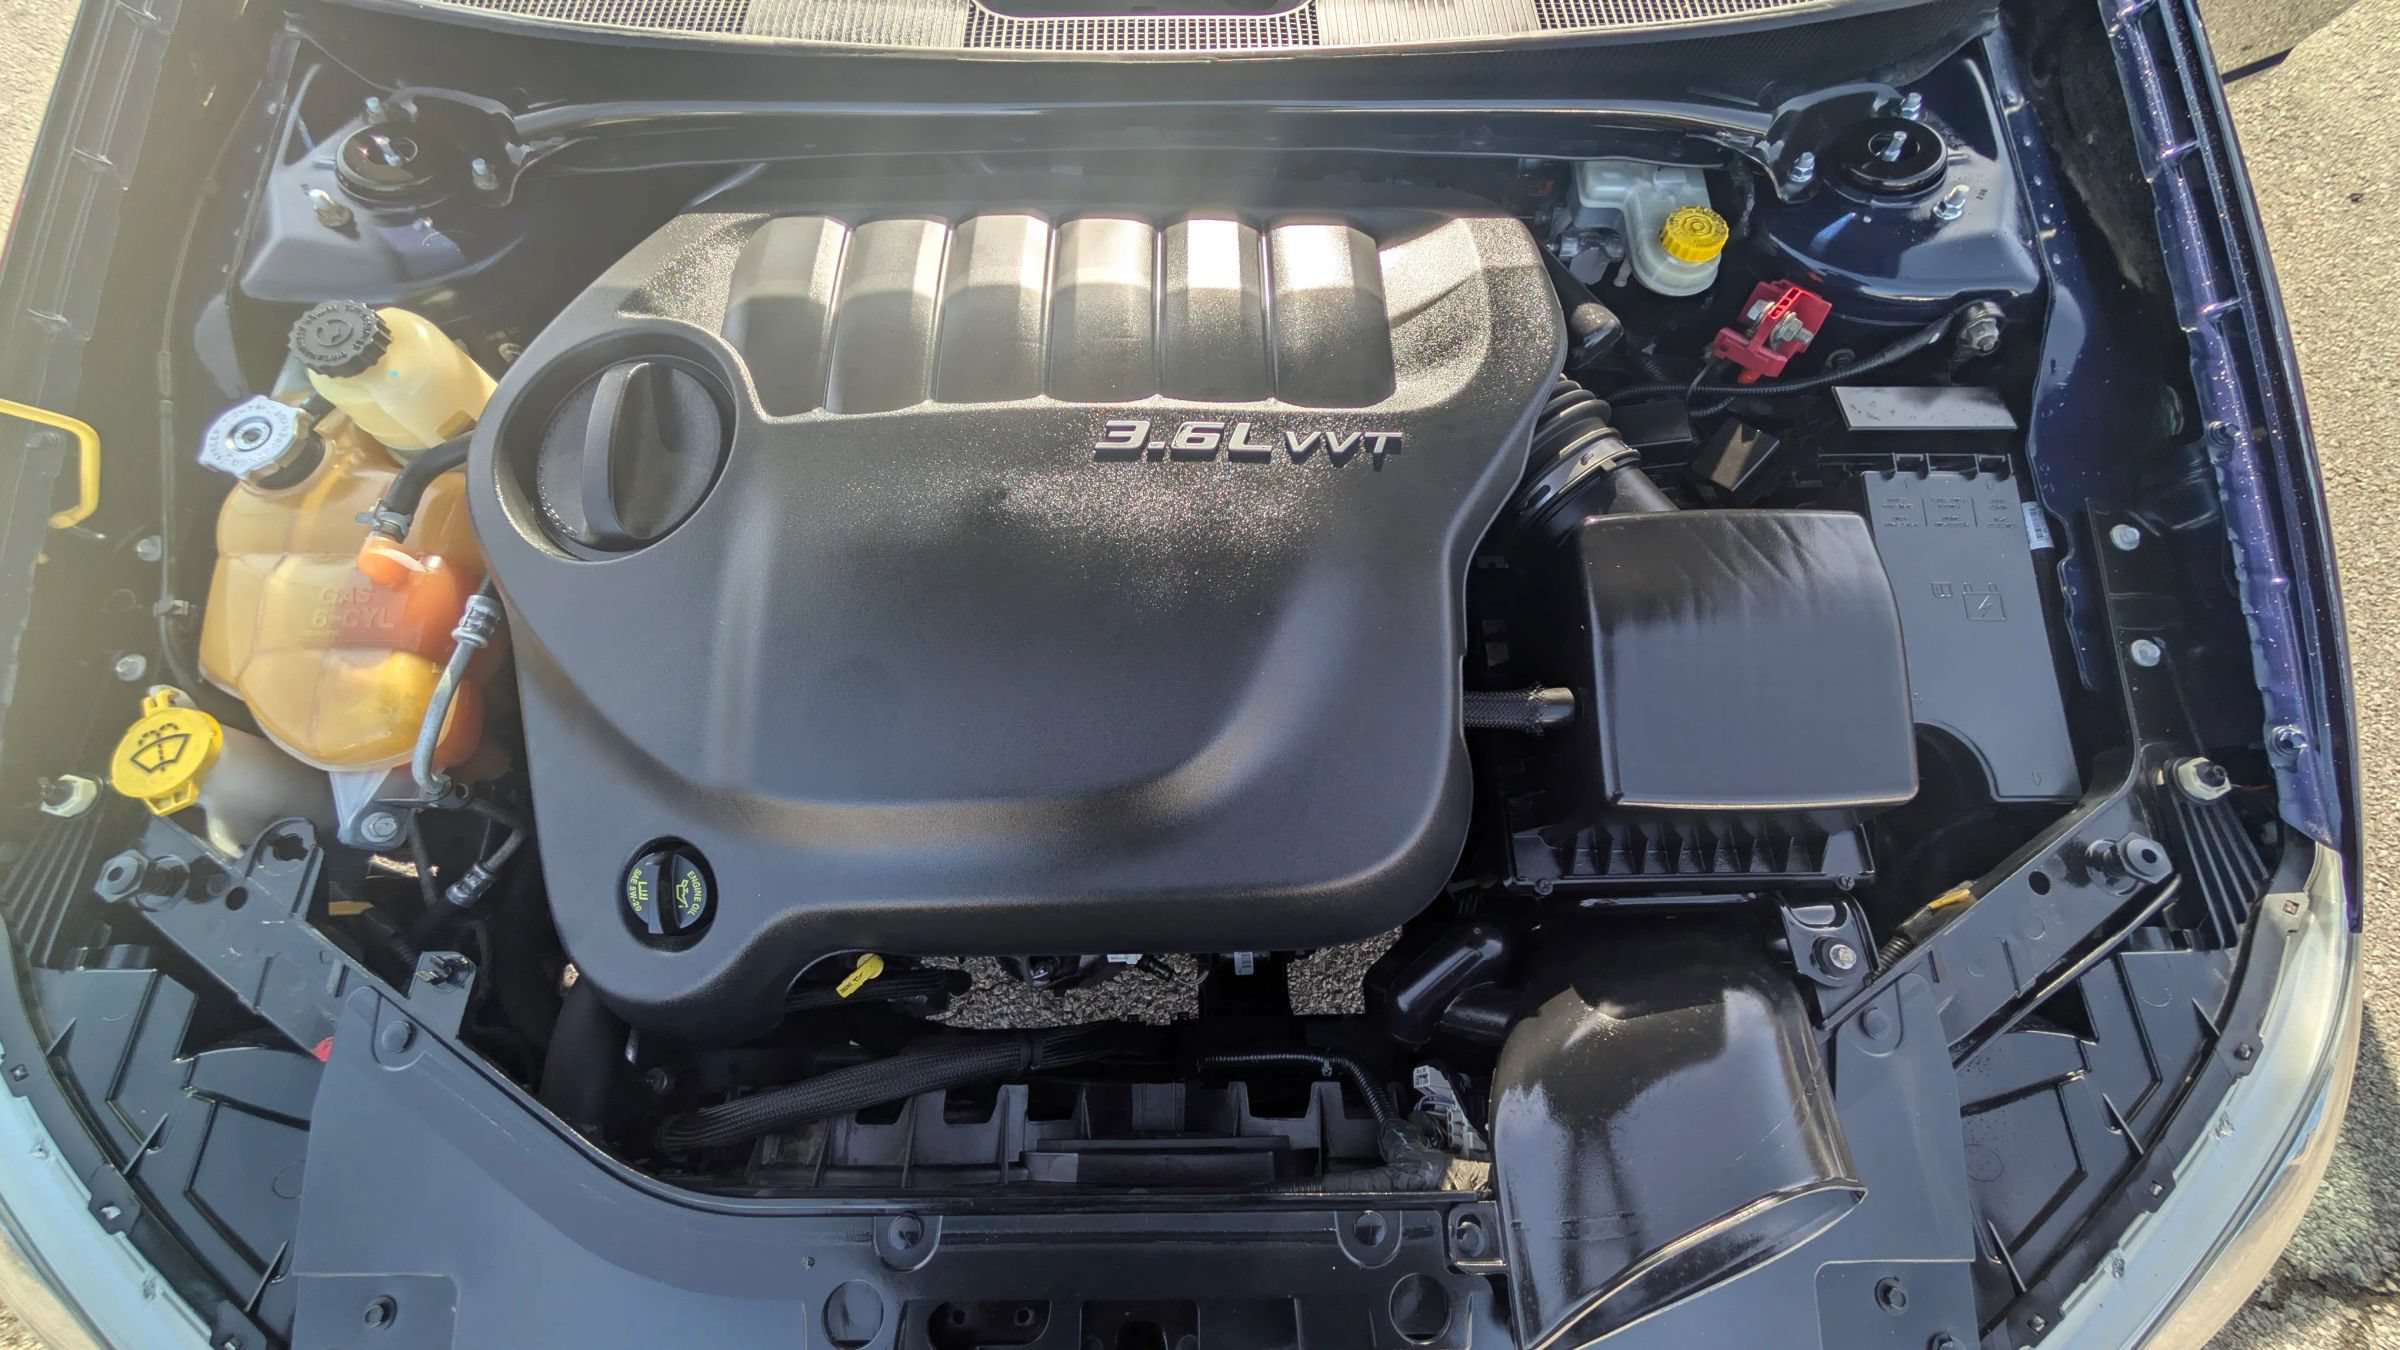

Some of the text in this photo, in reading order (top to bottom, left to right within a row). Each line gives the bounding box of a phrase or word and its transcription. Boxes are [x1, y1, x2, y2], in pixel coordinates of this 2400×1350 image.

[1095, 419, 1404, 458] 3.6L VVT
[629, 868, 642, 912] SAE 5W-20
[687, 870, 702, 916] ENGINE OIL
